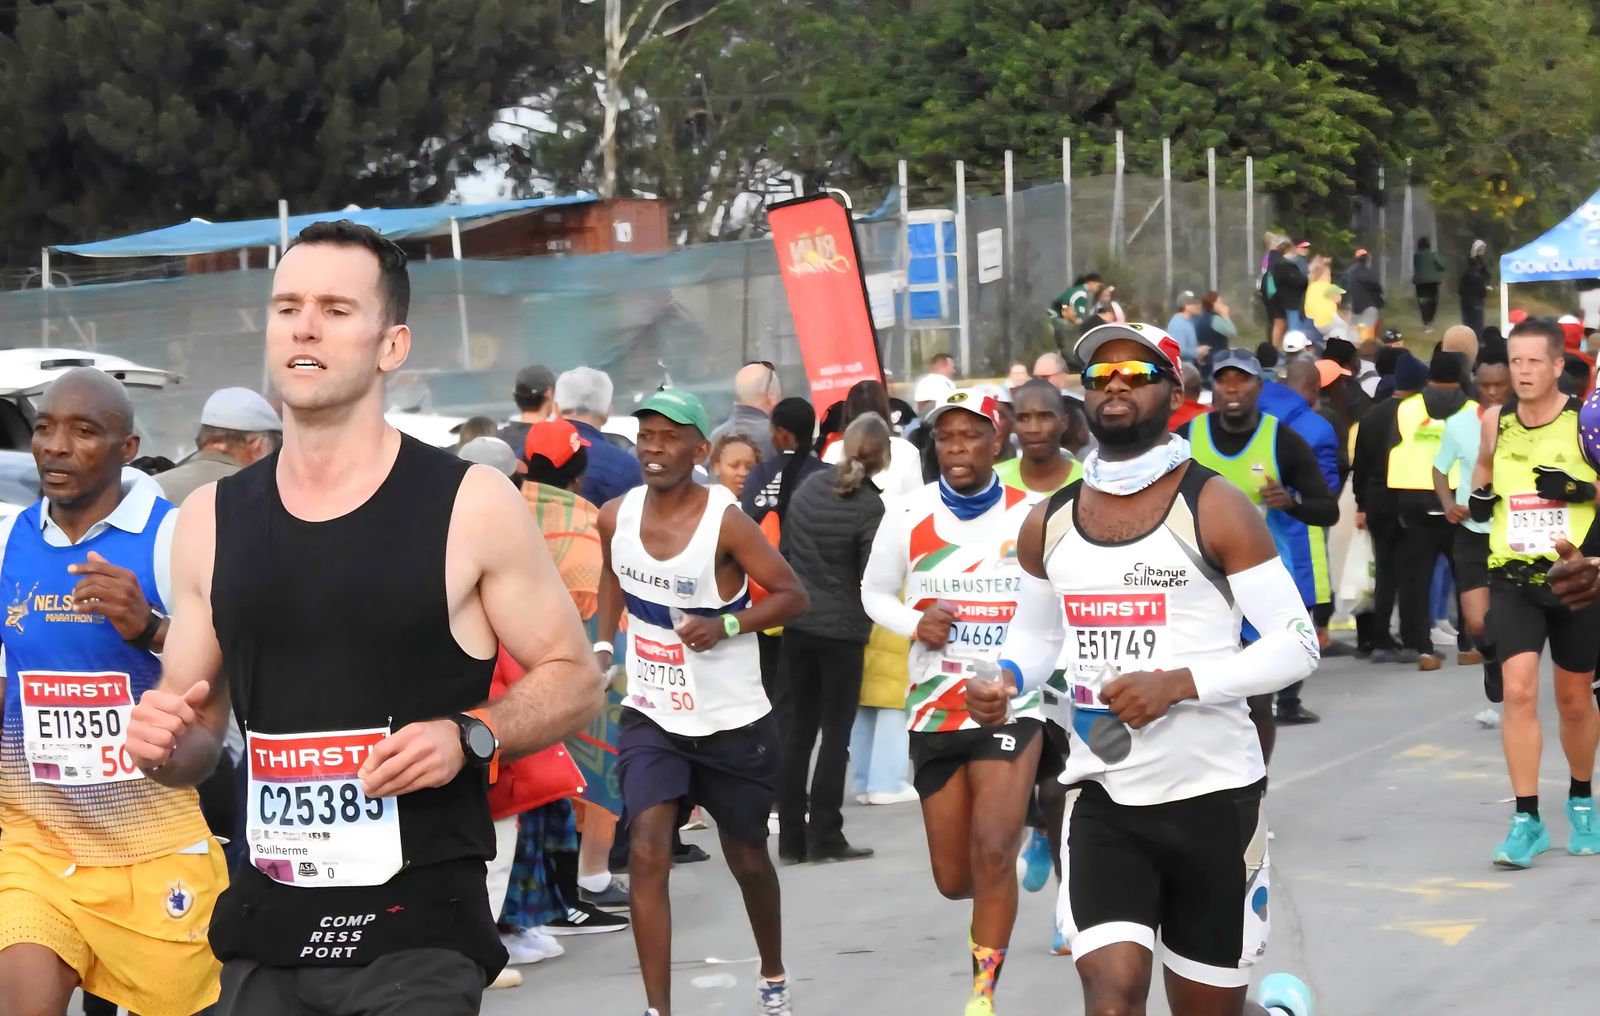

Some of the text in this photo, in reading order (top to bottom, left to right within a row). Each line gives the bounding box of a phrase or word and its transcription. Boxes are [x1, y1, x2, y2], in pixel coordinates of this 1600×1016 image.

[620, 565, 670, 590] CALLIES
[920, 577, 1021, 593] HILLBUSTERZ
[1123, 572, 1189, 588] Stillwater
[34, 595, 75, 611] NELS
[953, 604, 1016, 618] HIRSTI
[1068, 601, 1158, 616] THIRSTI
[949, 623, 1009, 646] D4662
[1076, 629, 1156, 660] E51749
[28, 682, 121, 698] THIRSTI
[671, 691, 694, 711] 50
[38, 709, 121, 739] E11350
[101, 744, 136, 778] 50
[260, 783, 384, 826] C25385
[256, 844, 308, 856] Guilherme
[320, 914, 376, 928] COMP
[310, 930, 362, 943] RESS
[300, 946, 357, 959] PORT
